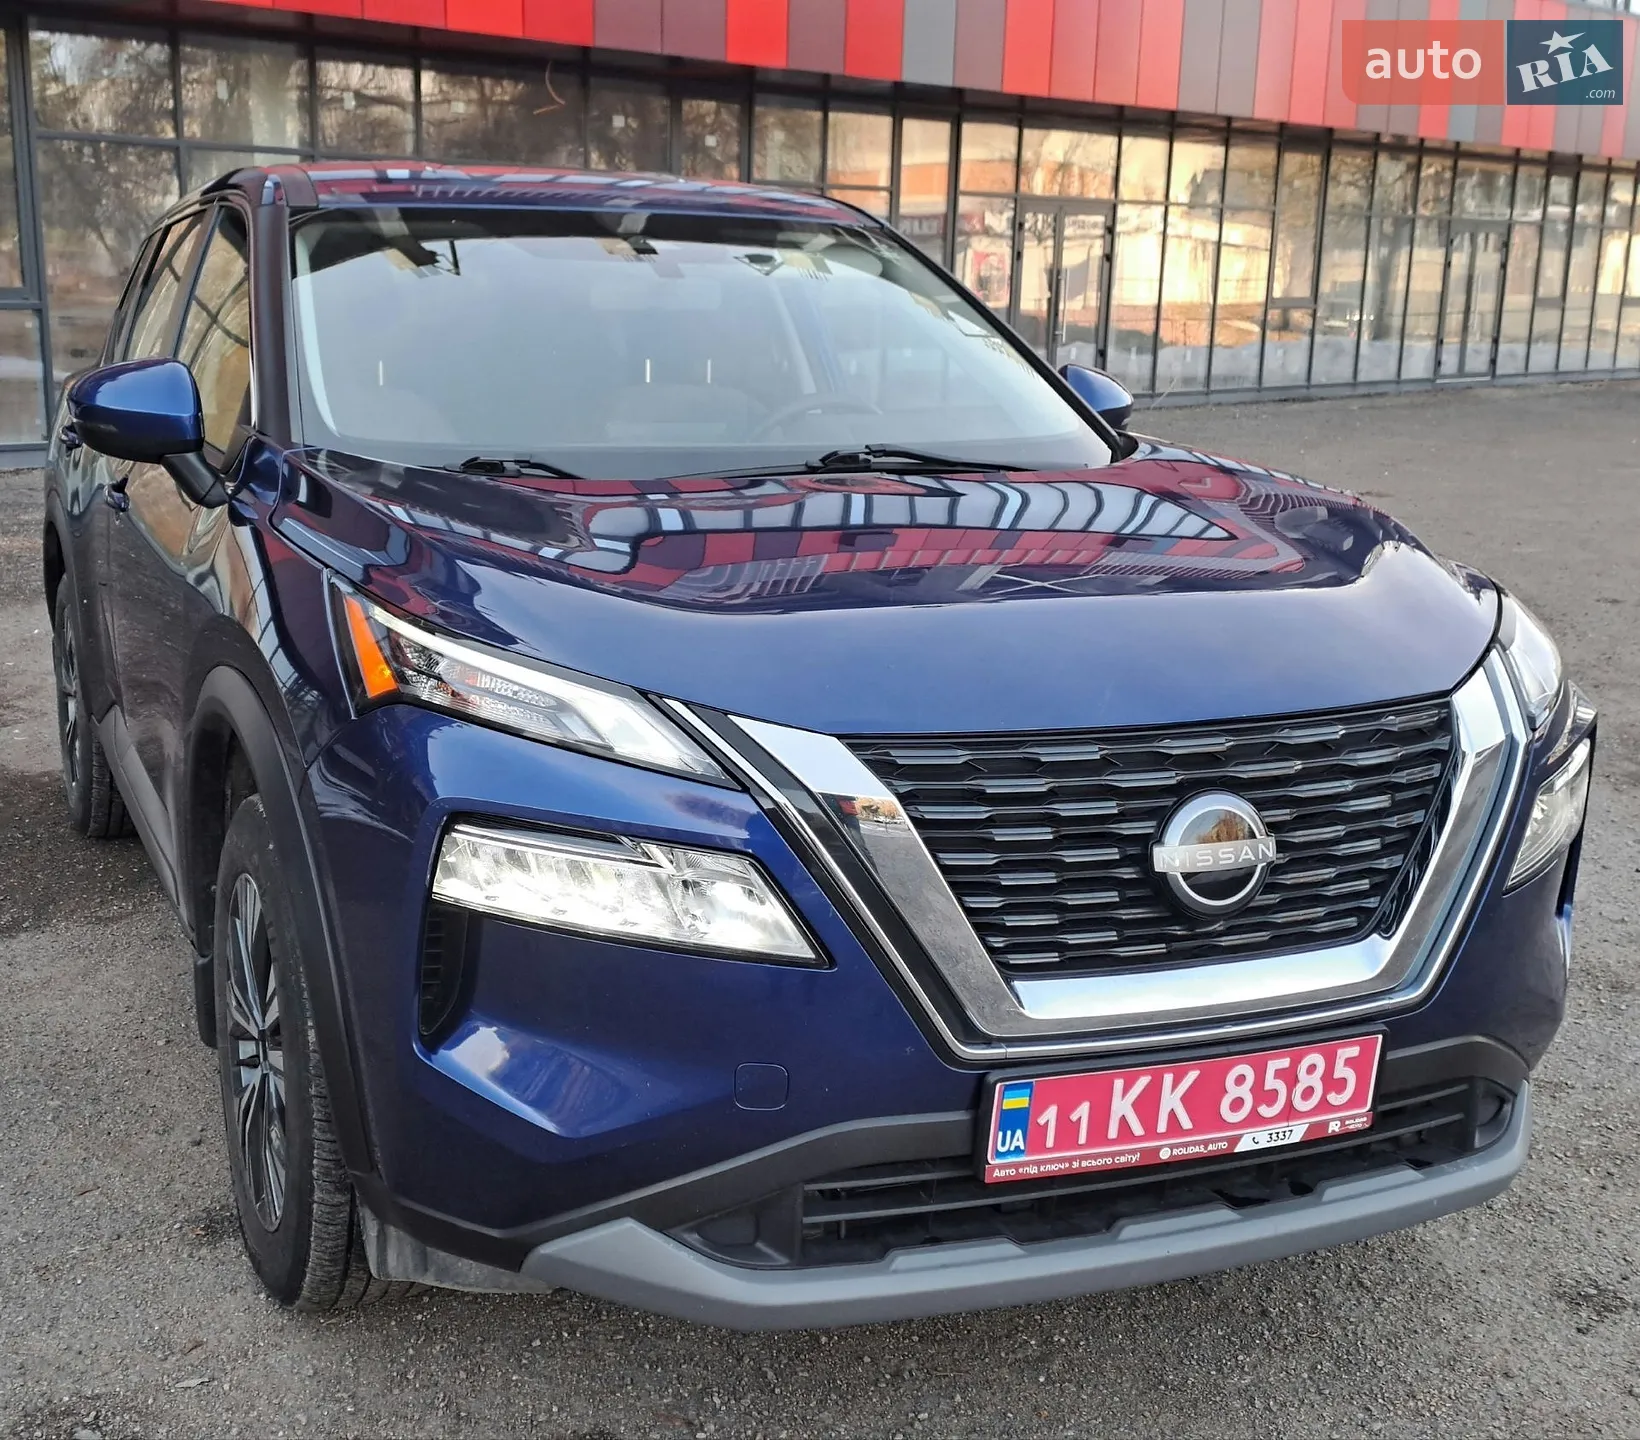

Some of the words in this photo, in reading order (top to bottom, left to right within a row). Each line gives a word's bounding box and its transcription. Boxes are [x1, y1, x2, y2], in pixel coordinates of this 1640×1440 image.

[1160, 841, 1274, 869] NISSAN
[1219, 1045, 1360, 1124] 8585
[997, 1129, 1025, 1153] UA
[1266, 1129, 1294, 1143] 3337
[993, 1168, 1016, 1177] Авто
[1081, 1157, 1113, 1167] всього
